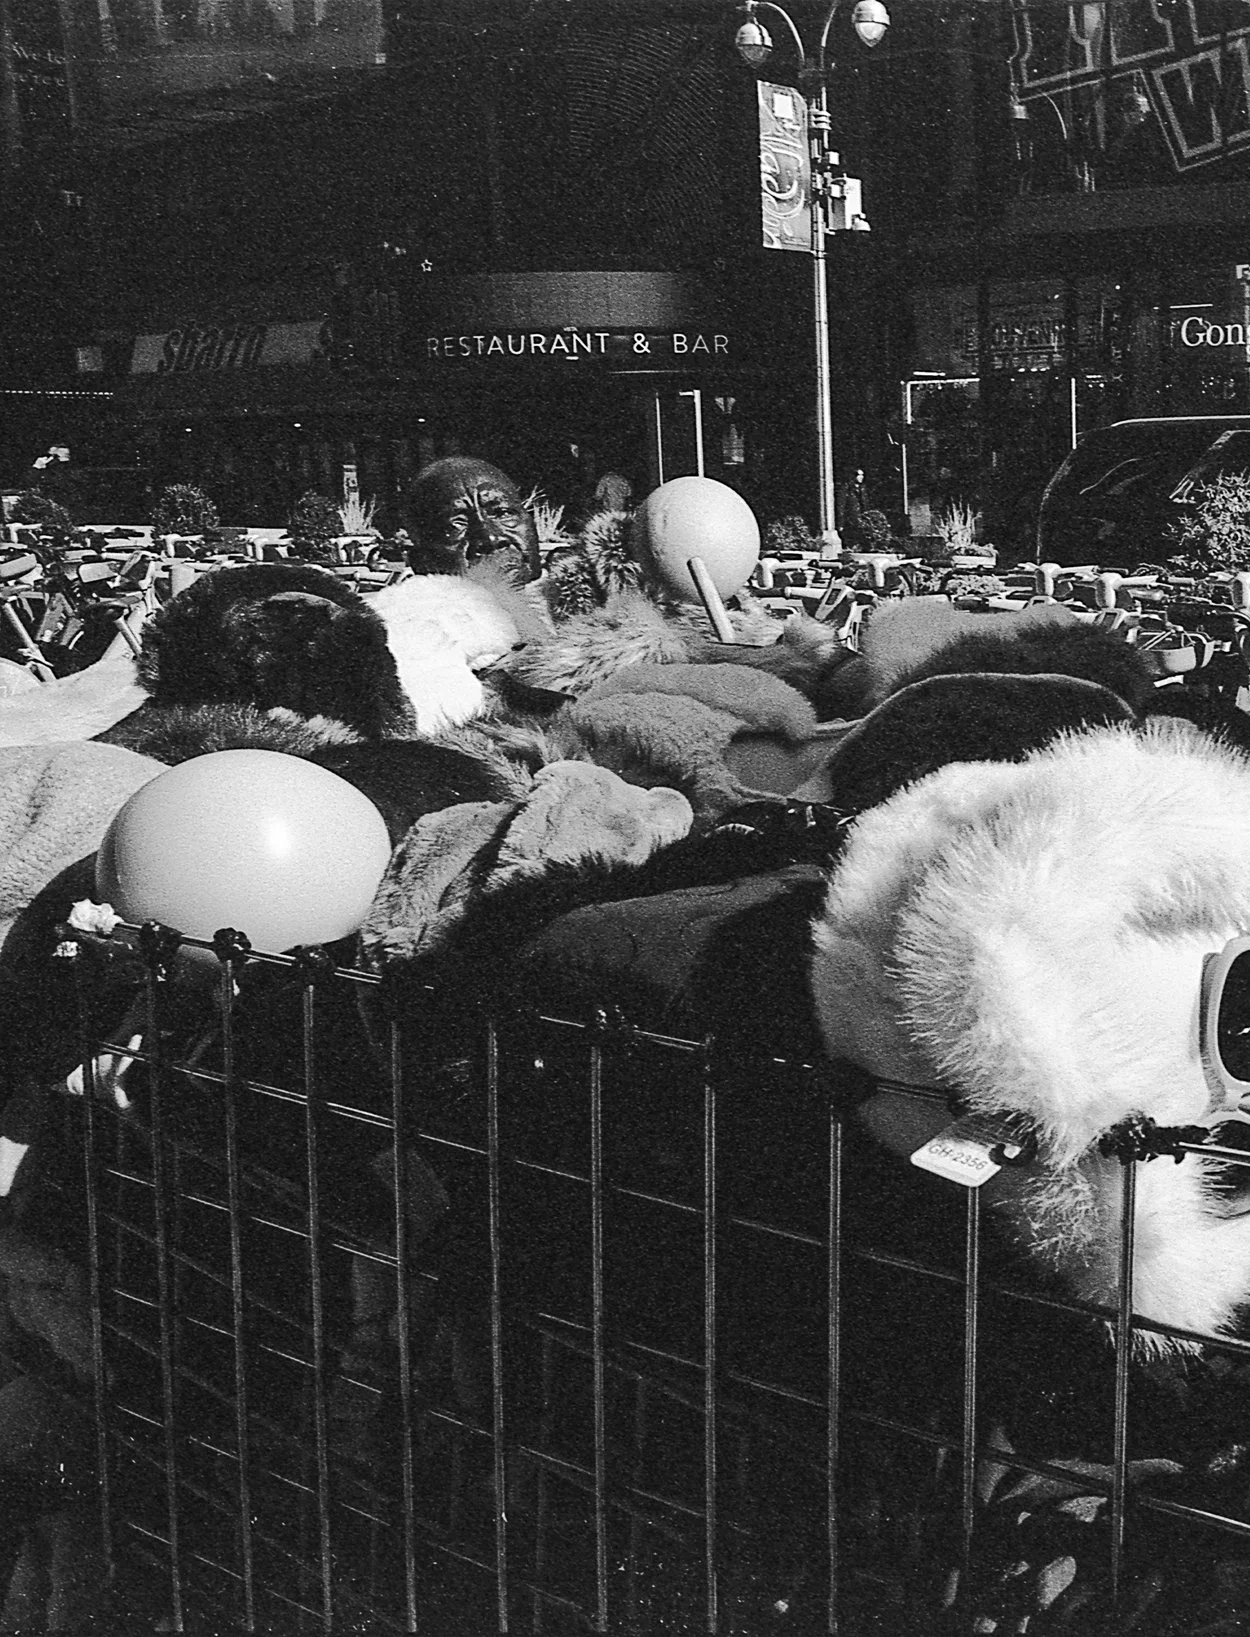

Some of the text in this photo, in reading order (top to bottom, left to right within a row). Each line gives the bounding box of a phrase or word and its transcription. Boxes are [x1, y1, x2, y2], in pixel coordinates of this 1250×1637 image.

[426, 332, 729, 358] RESTAURANT & BAR
